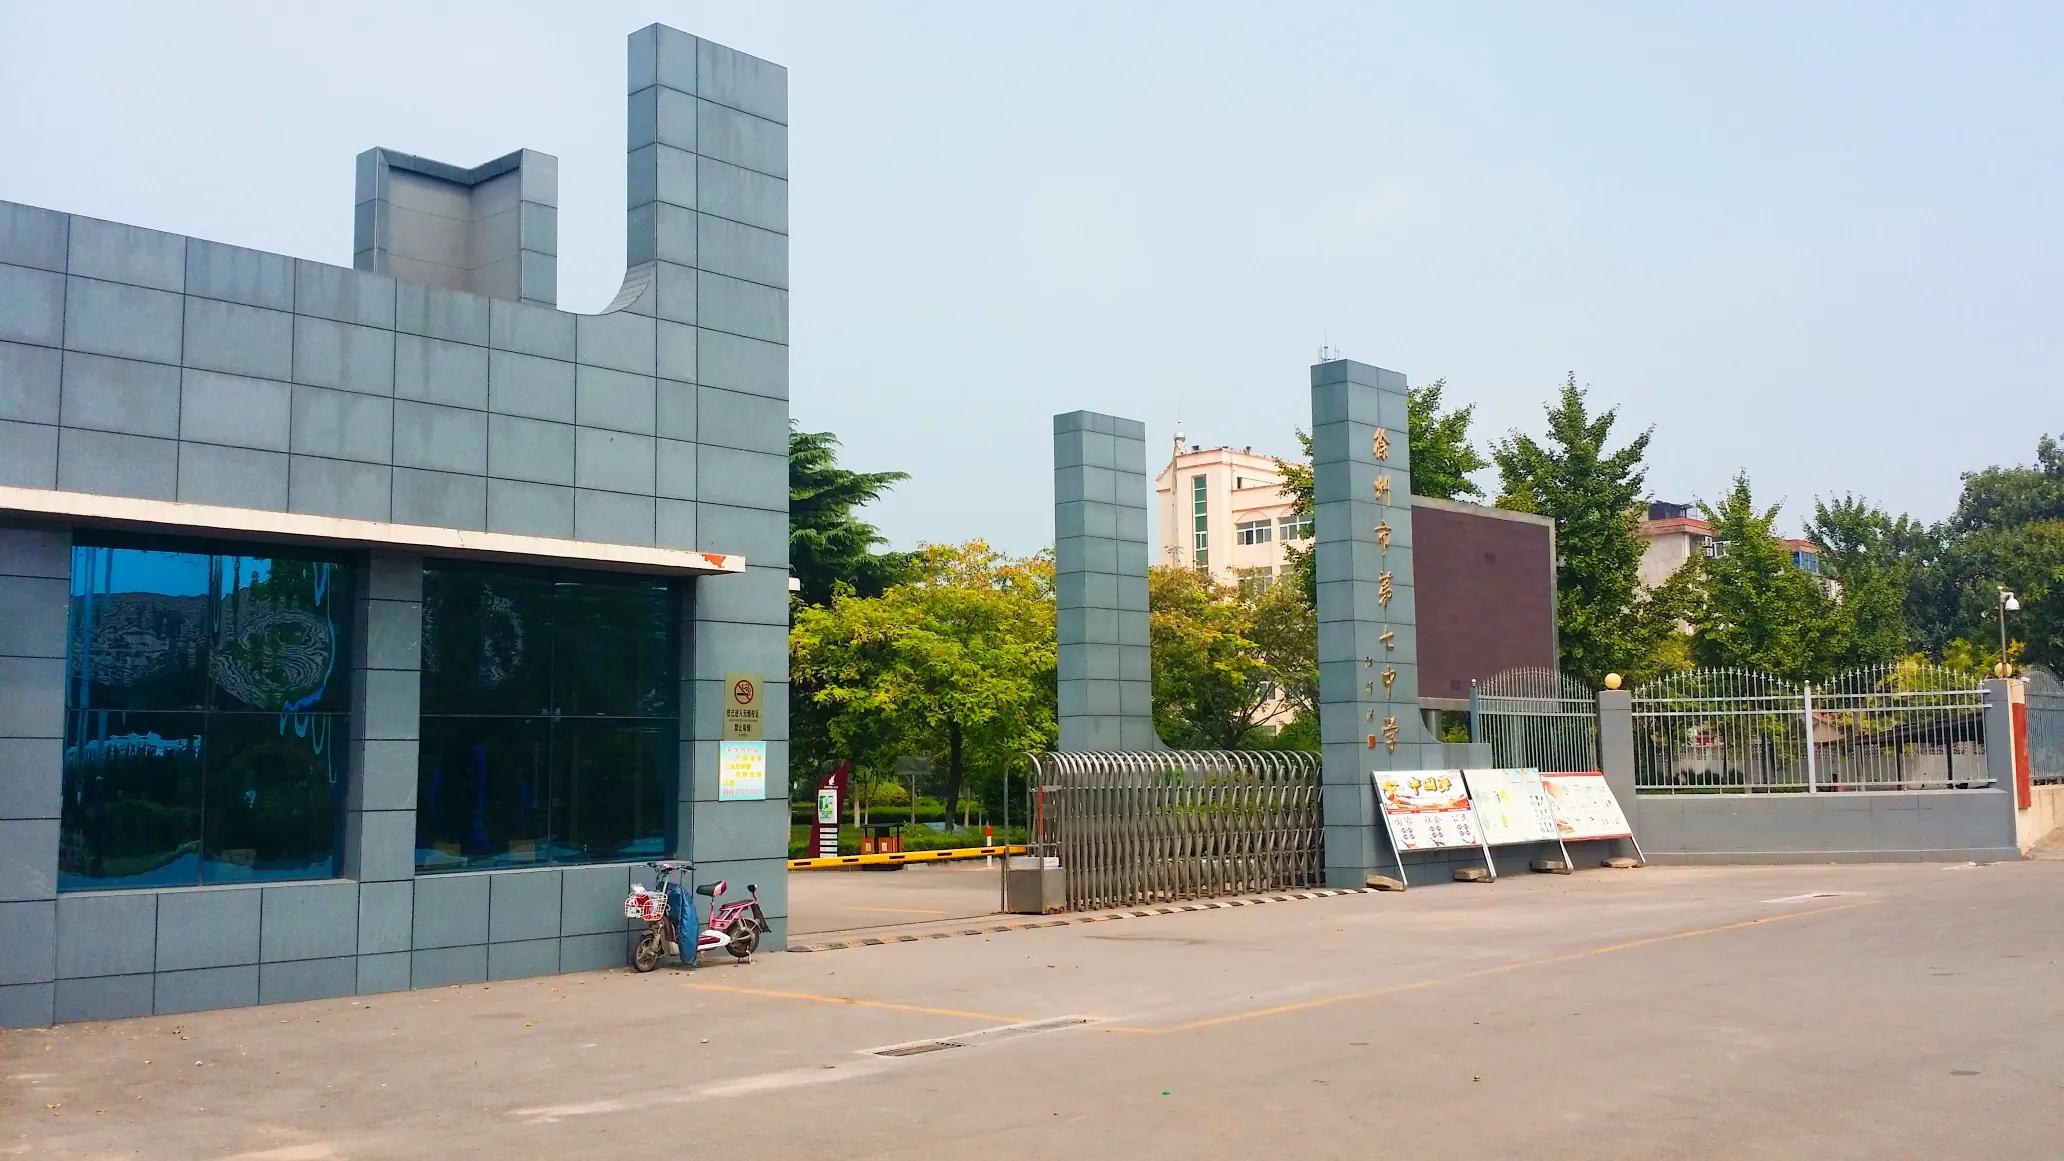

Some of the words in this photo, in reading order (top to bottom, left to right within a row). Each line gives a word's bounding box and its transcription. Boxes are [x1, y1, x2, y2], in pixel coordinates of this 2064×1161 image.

[1372, 427, 1400, 753] 徐州市第七中学
